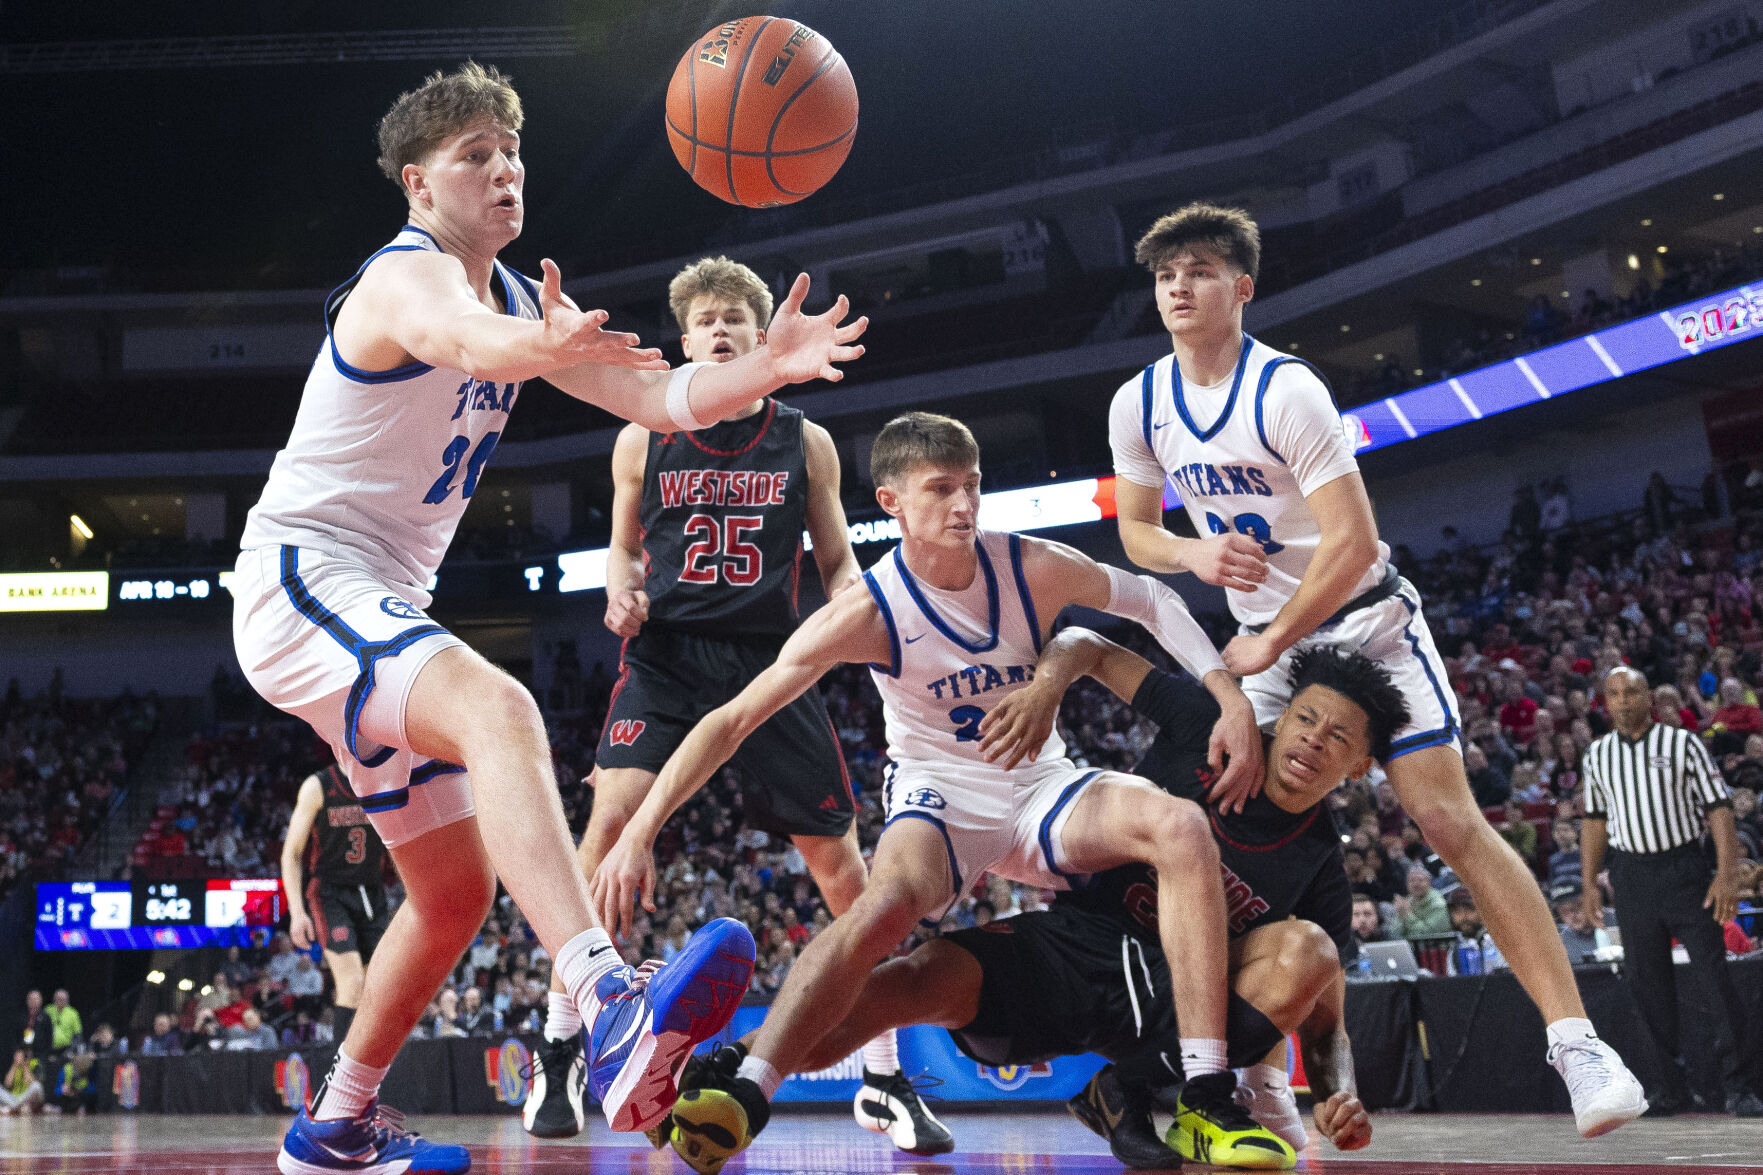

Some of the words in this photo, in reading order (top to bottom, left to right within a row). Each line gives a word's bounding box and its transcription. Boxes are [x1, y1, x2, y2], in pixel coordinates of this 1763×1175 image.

[209, 344, 245, 359] 214
[659, 469, 789, 508] WESTSIDE
[678, 514, 763, 586] 25
[610, 719, 646, 747] W
[345, 826, 367, 864] 3
[146, 898, 191, 920] 5:42
